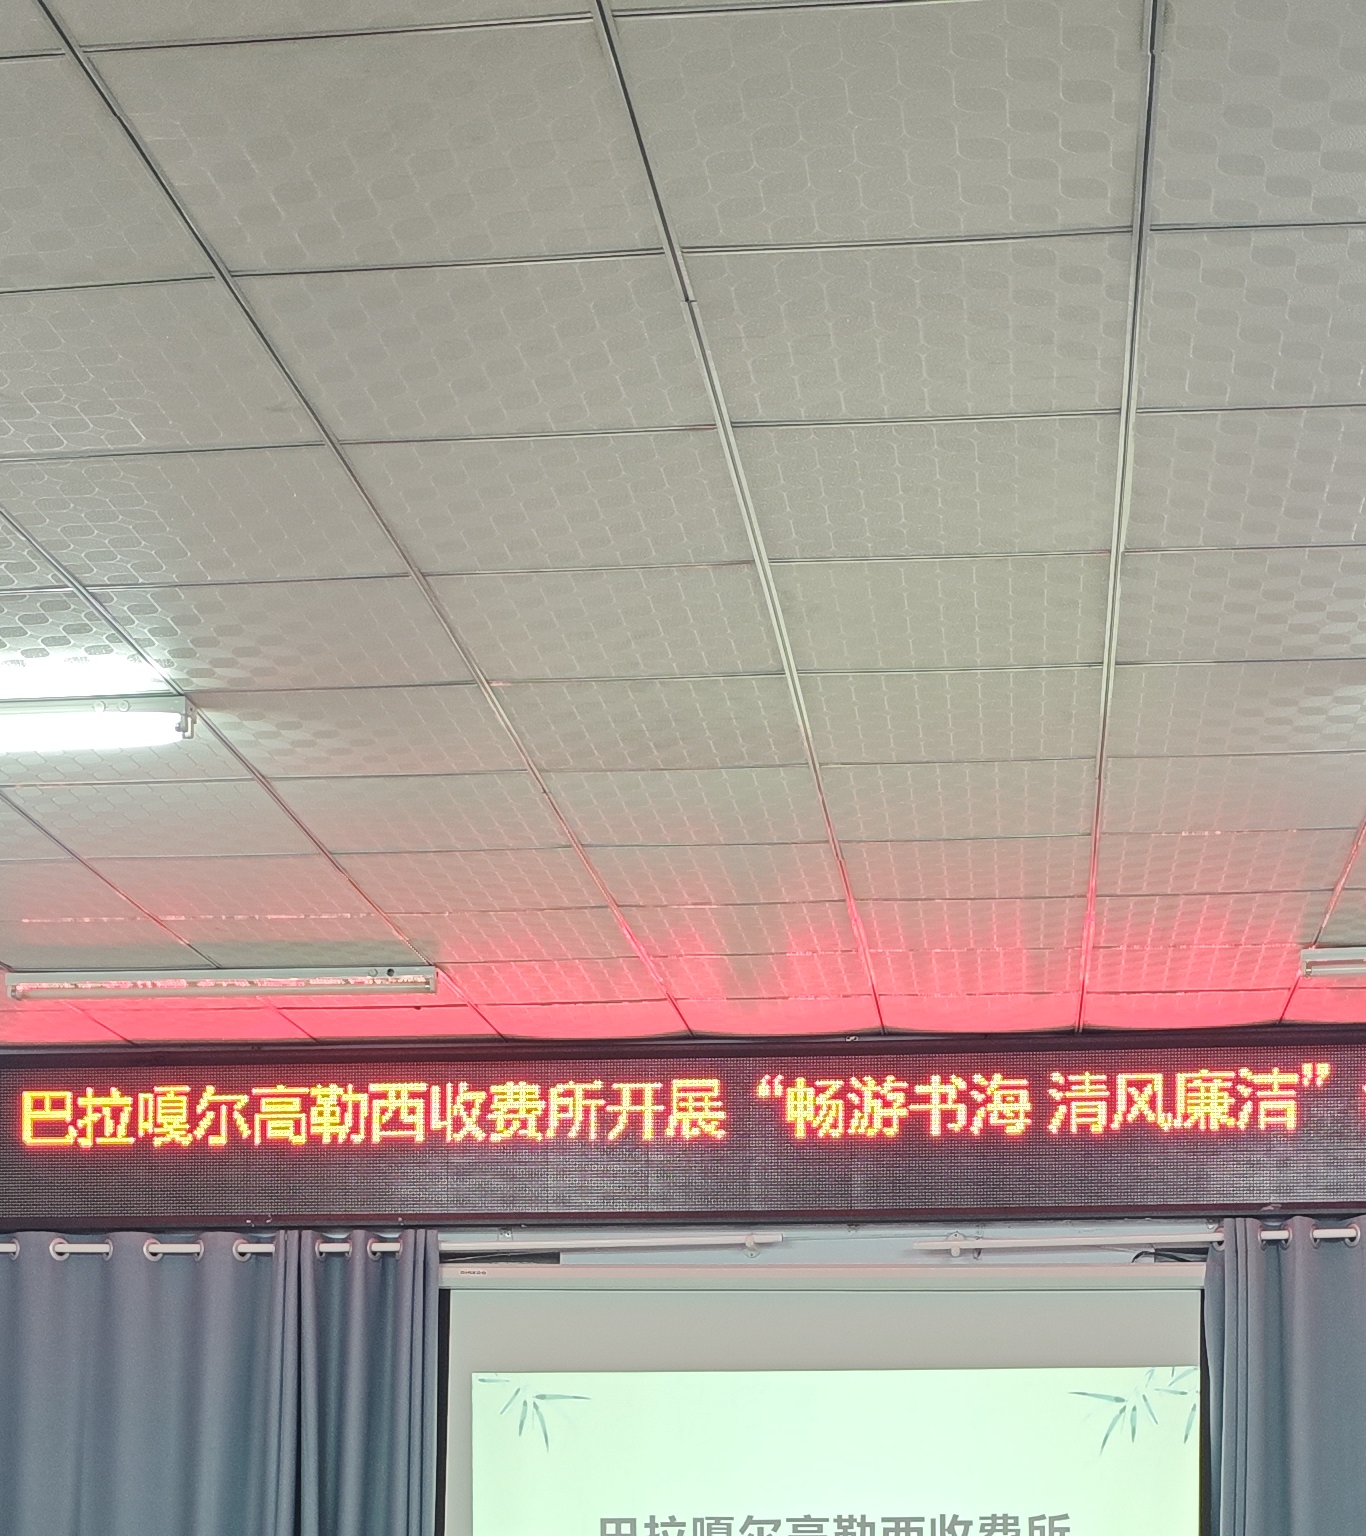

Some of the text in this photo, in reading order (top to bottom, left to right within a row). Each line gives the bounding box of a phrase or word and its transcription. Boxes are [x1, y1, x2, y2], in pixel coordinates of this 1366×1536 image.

[20, 1077, 727, 1147] 巴拉嘎尔高勒西收费所开展
